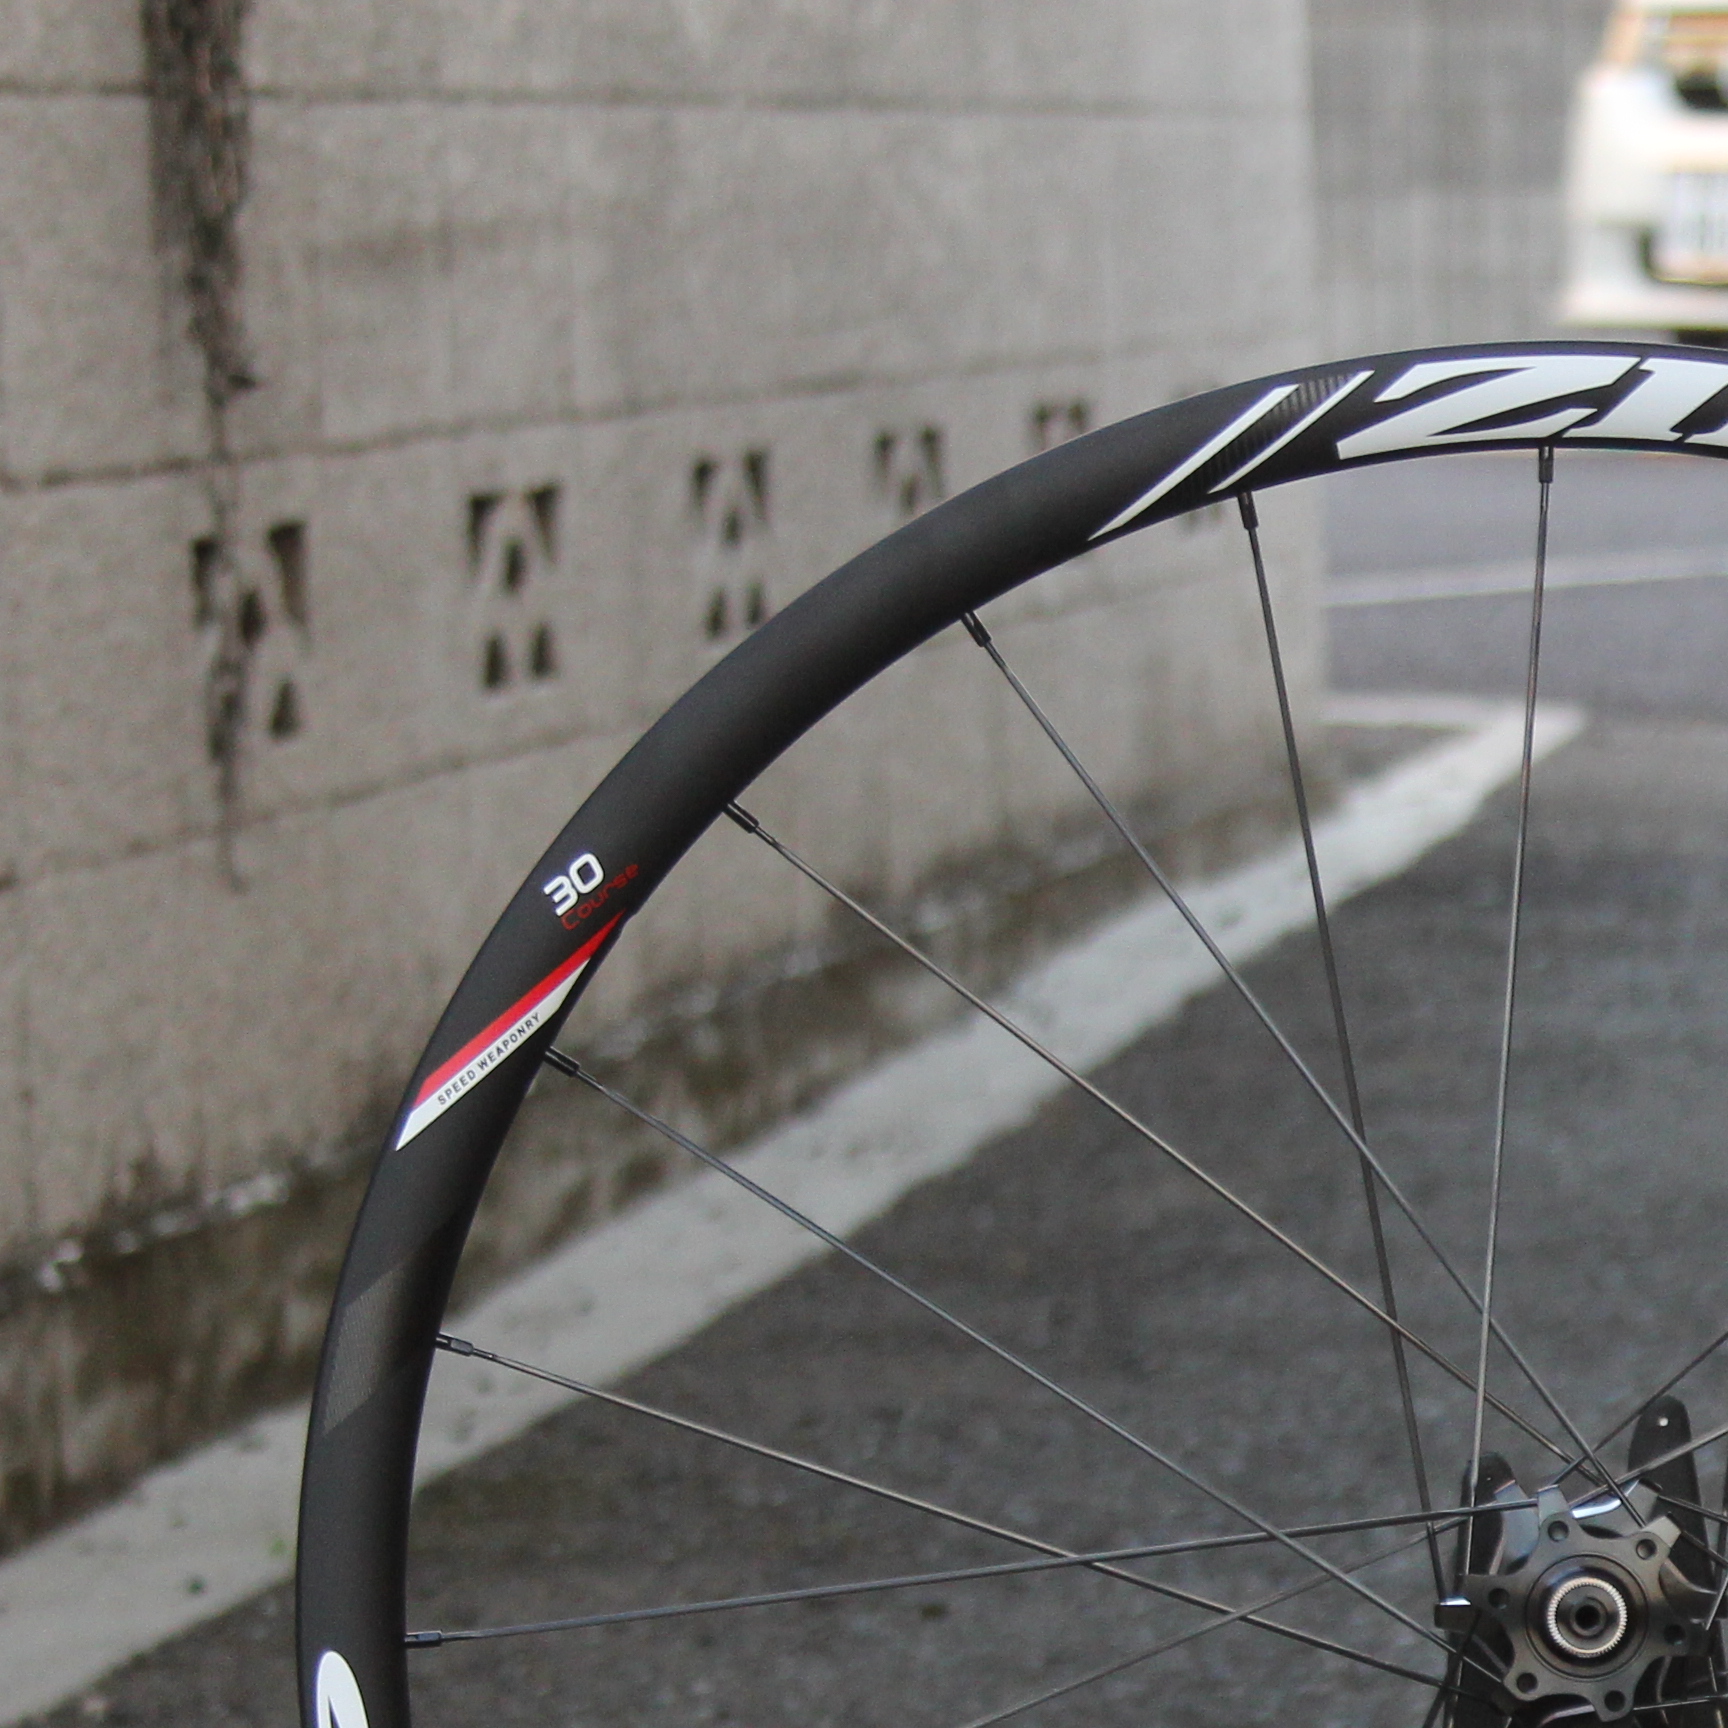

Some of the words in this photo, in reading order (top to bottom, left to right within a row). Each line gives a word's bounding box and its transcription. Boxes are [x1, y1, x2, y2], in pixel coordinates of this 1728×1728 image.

[544, 853, 604, 917] 30
[561, 864, 639, 930] Course
[437, 1069, 476, 1105] SPEED
[477, 1012, 540, 1071] WEAPONRY
